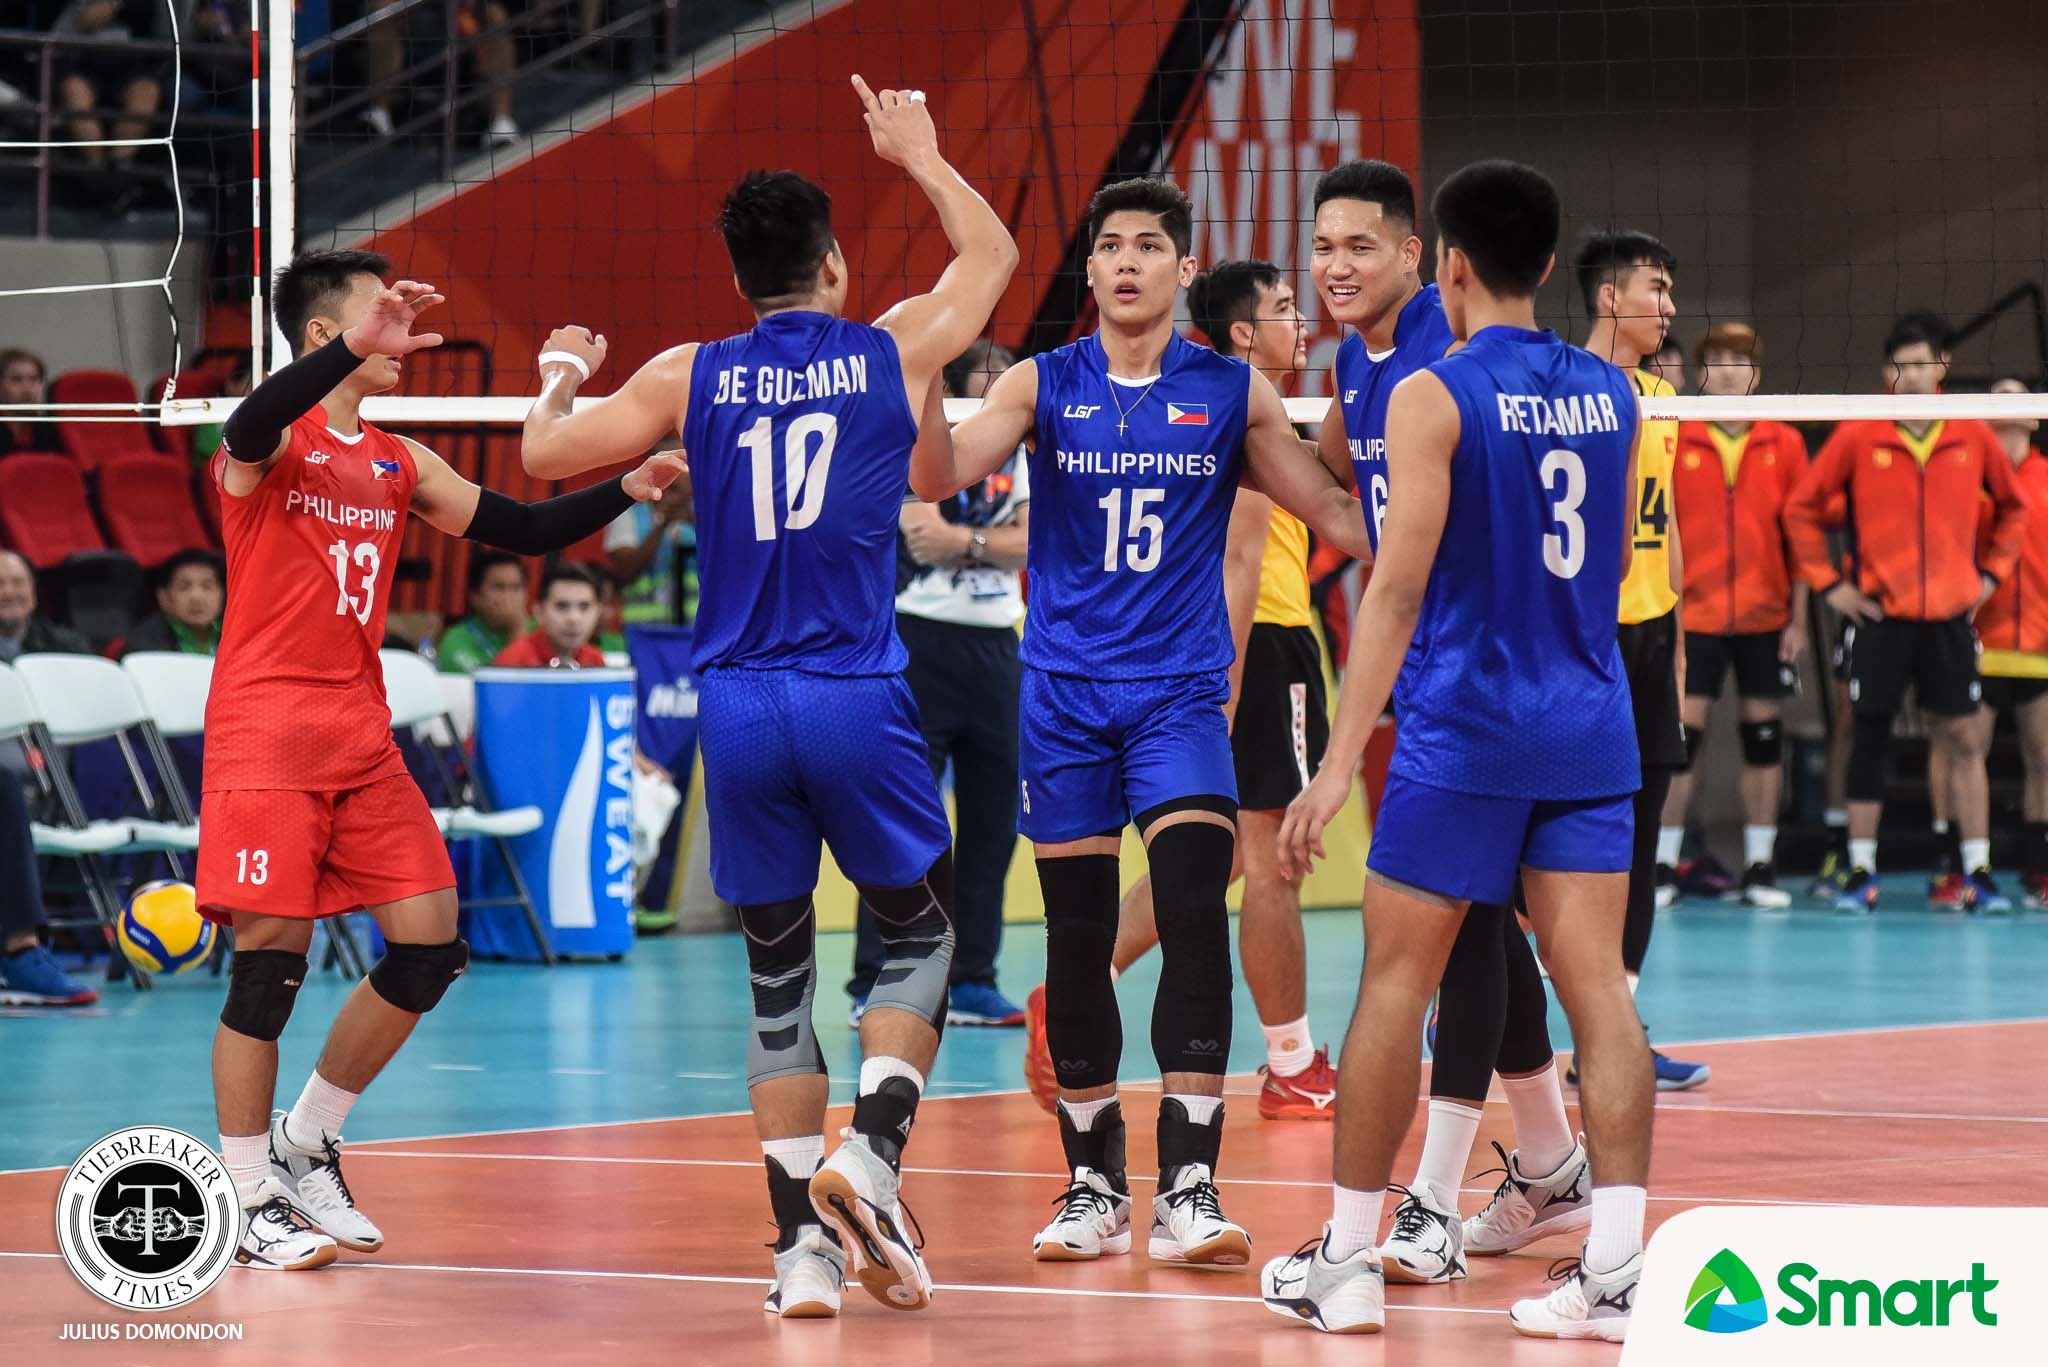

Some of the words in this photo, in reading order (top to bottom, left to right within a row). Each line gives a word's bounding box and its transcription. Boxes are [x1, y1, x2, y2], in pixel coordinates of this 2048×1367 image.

[714, 366, 748, 405] DE
[756, 354, 867, 406] GUZMAN
[1497, 392, 1619, 436] RETAMAR
[737, 412, 838, 542] 10
[1056, 449, 1217, 476] PHILIPPINES
[1098, 487, 1166, 573] 15
[1540, 449, 1587, 580] 3
[328, 539, 381, 626] 13
[236, 848, 269, 886] 13
